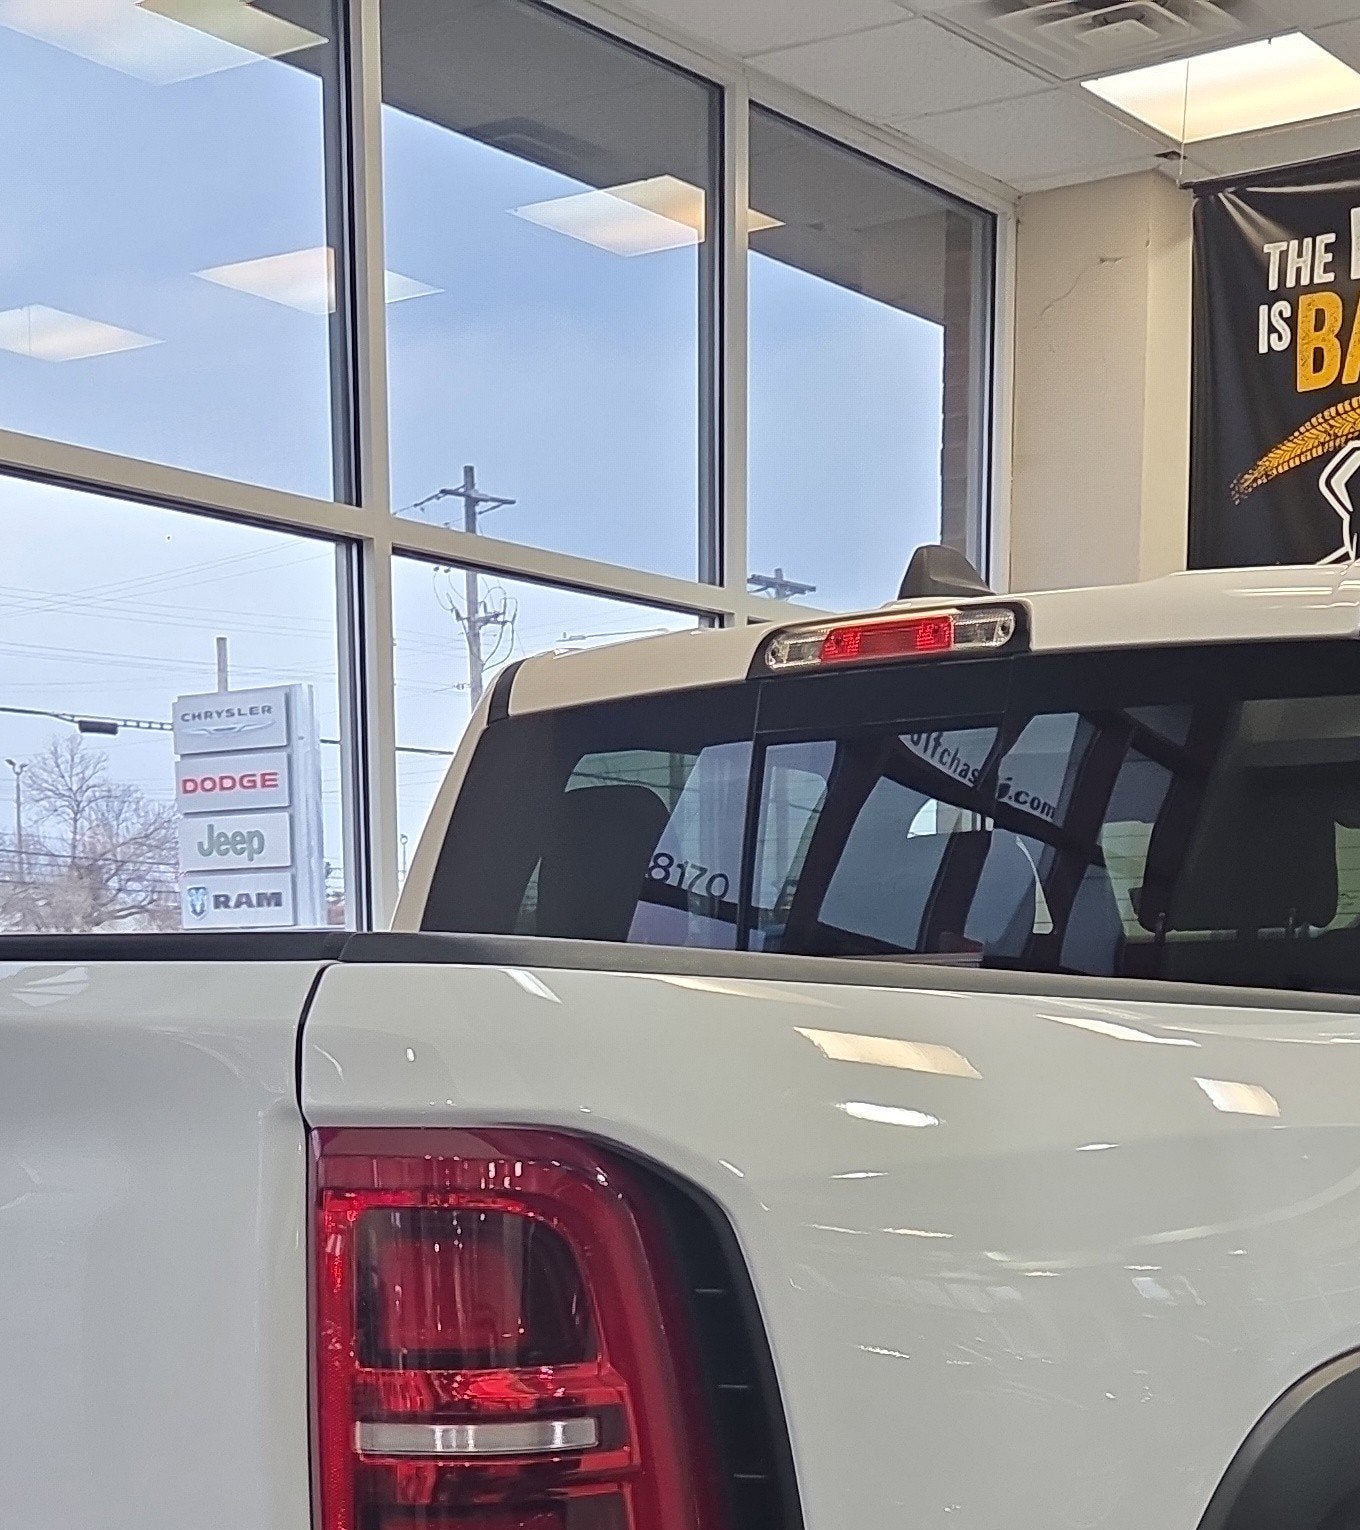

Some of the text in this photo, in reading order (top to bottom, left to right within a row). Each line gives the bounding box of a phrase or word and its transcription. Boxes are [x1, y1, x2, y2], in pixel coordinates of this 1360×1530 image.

[1263, 232, 1337, 292] THE
[1258, 300, 1292, 354] IS
[180, 704, 273, 723] CHRYSLER
[181, 772, 280, 795] DODGE
[196, 823, 266, 862] Jeep
[212, 891, 284, 910] RAM
